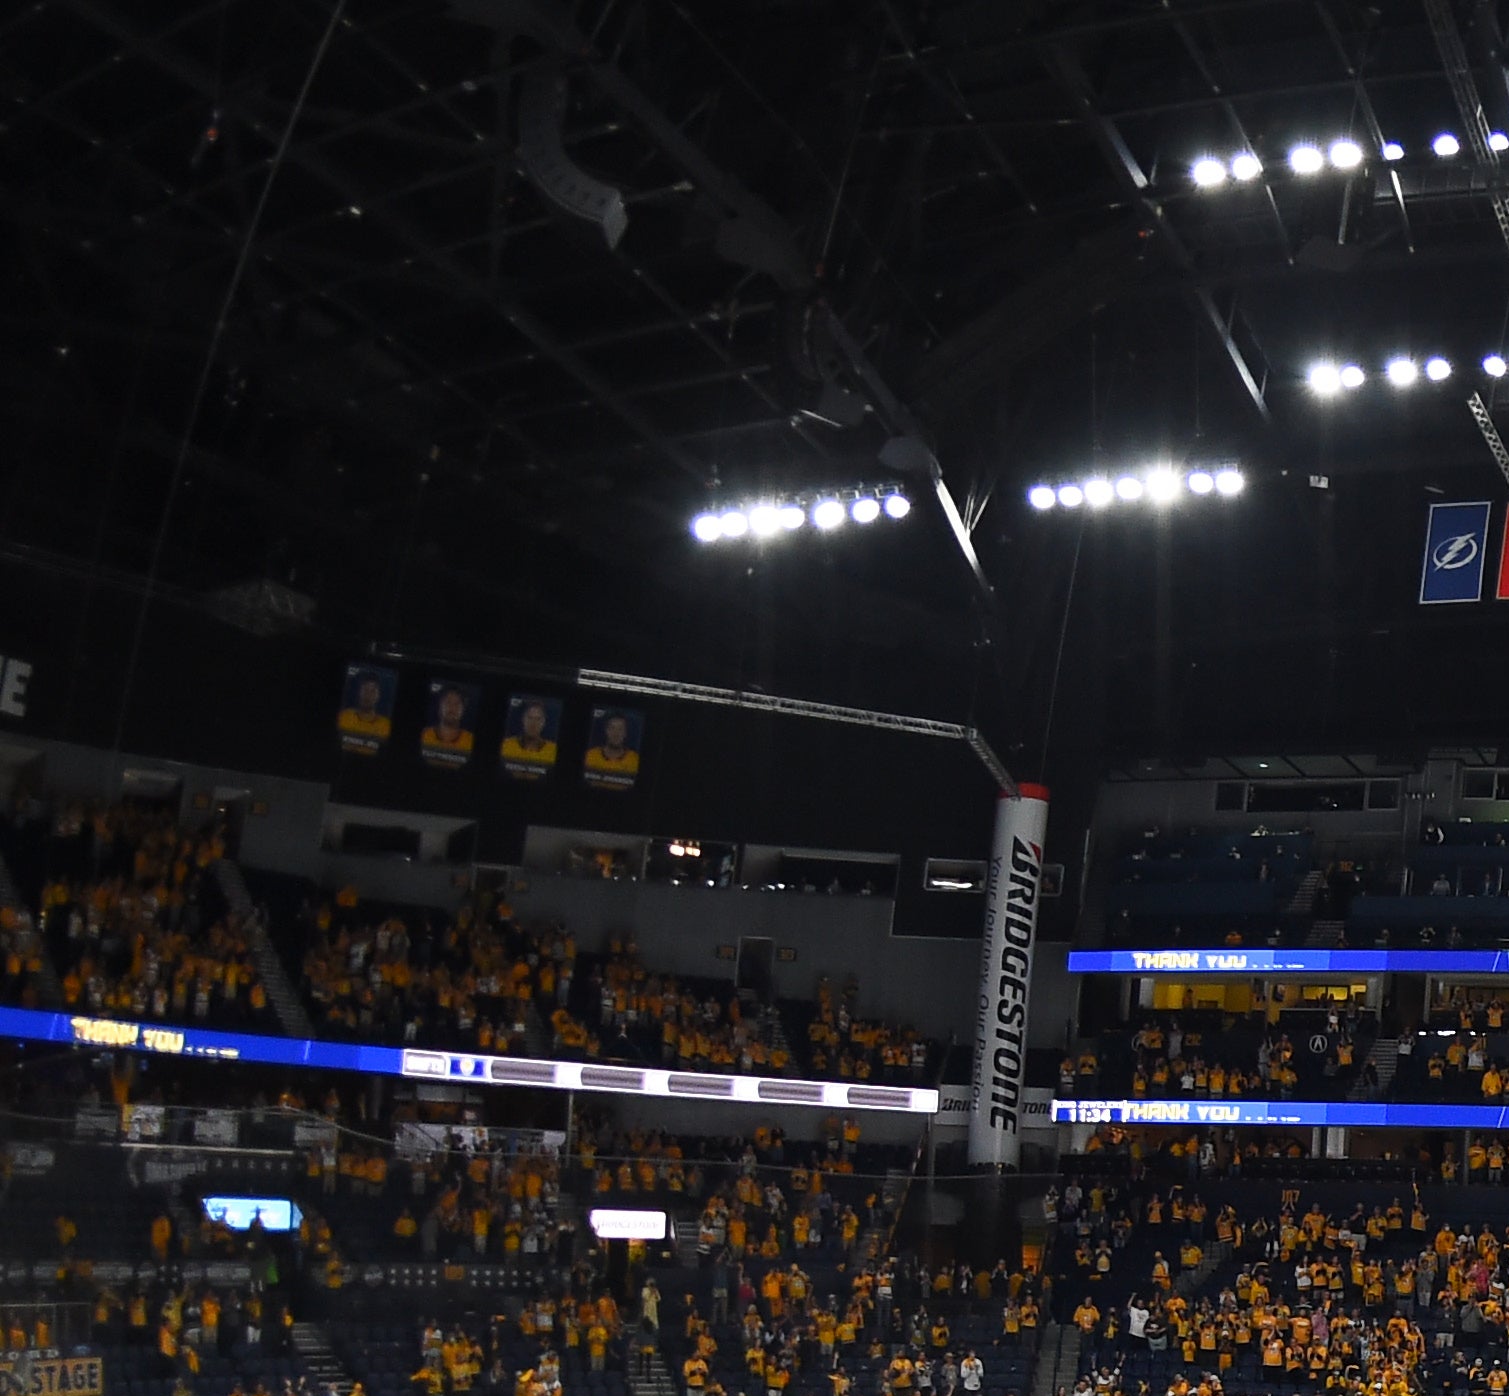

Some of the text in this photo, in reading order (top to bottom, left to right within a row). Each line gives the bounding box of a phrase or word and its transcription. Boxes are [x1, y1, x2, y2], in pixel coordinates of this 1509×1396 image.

[1132, 952, 1198, 969] THANK
[989, 834, 1041, 1136] BRIDGESTONE
[1126, 1102, 1240, 1121] THANK YOU
[31, 1364, 99, 1396] STAGE
